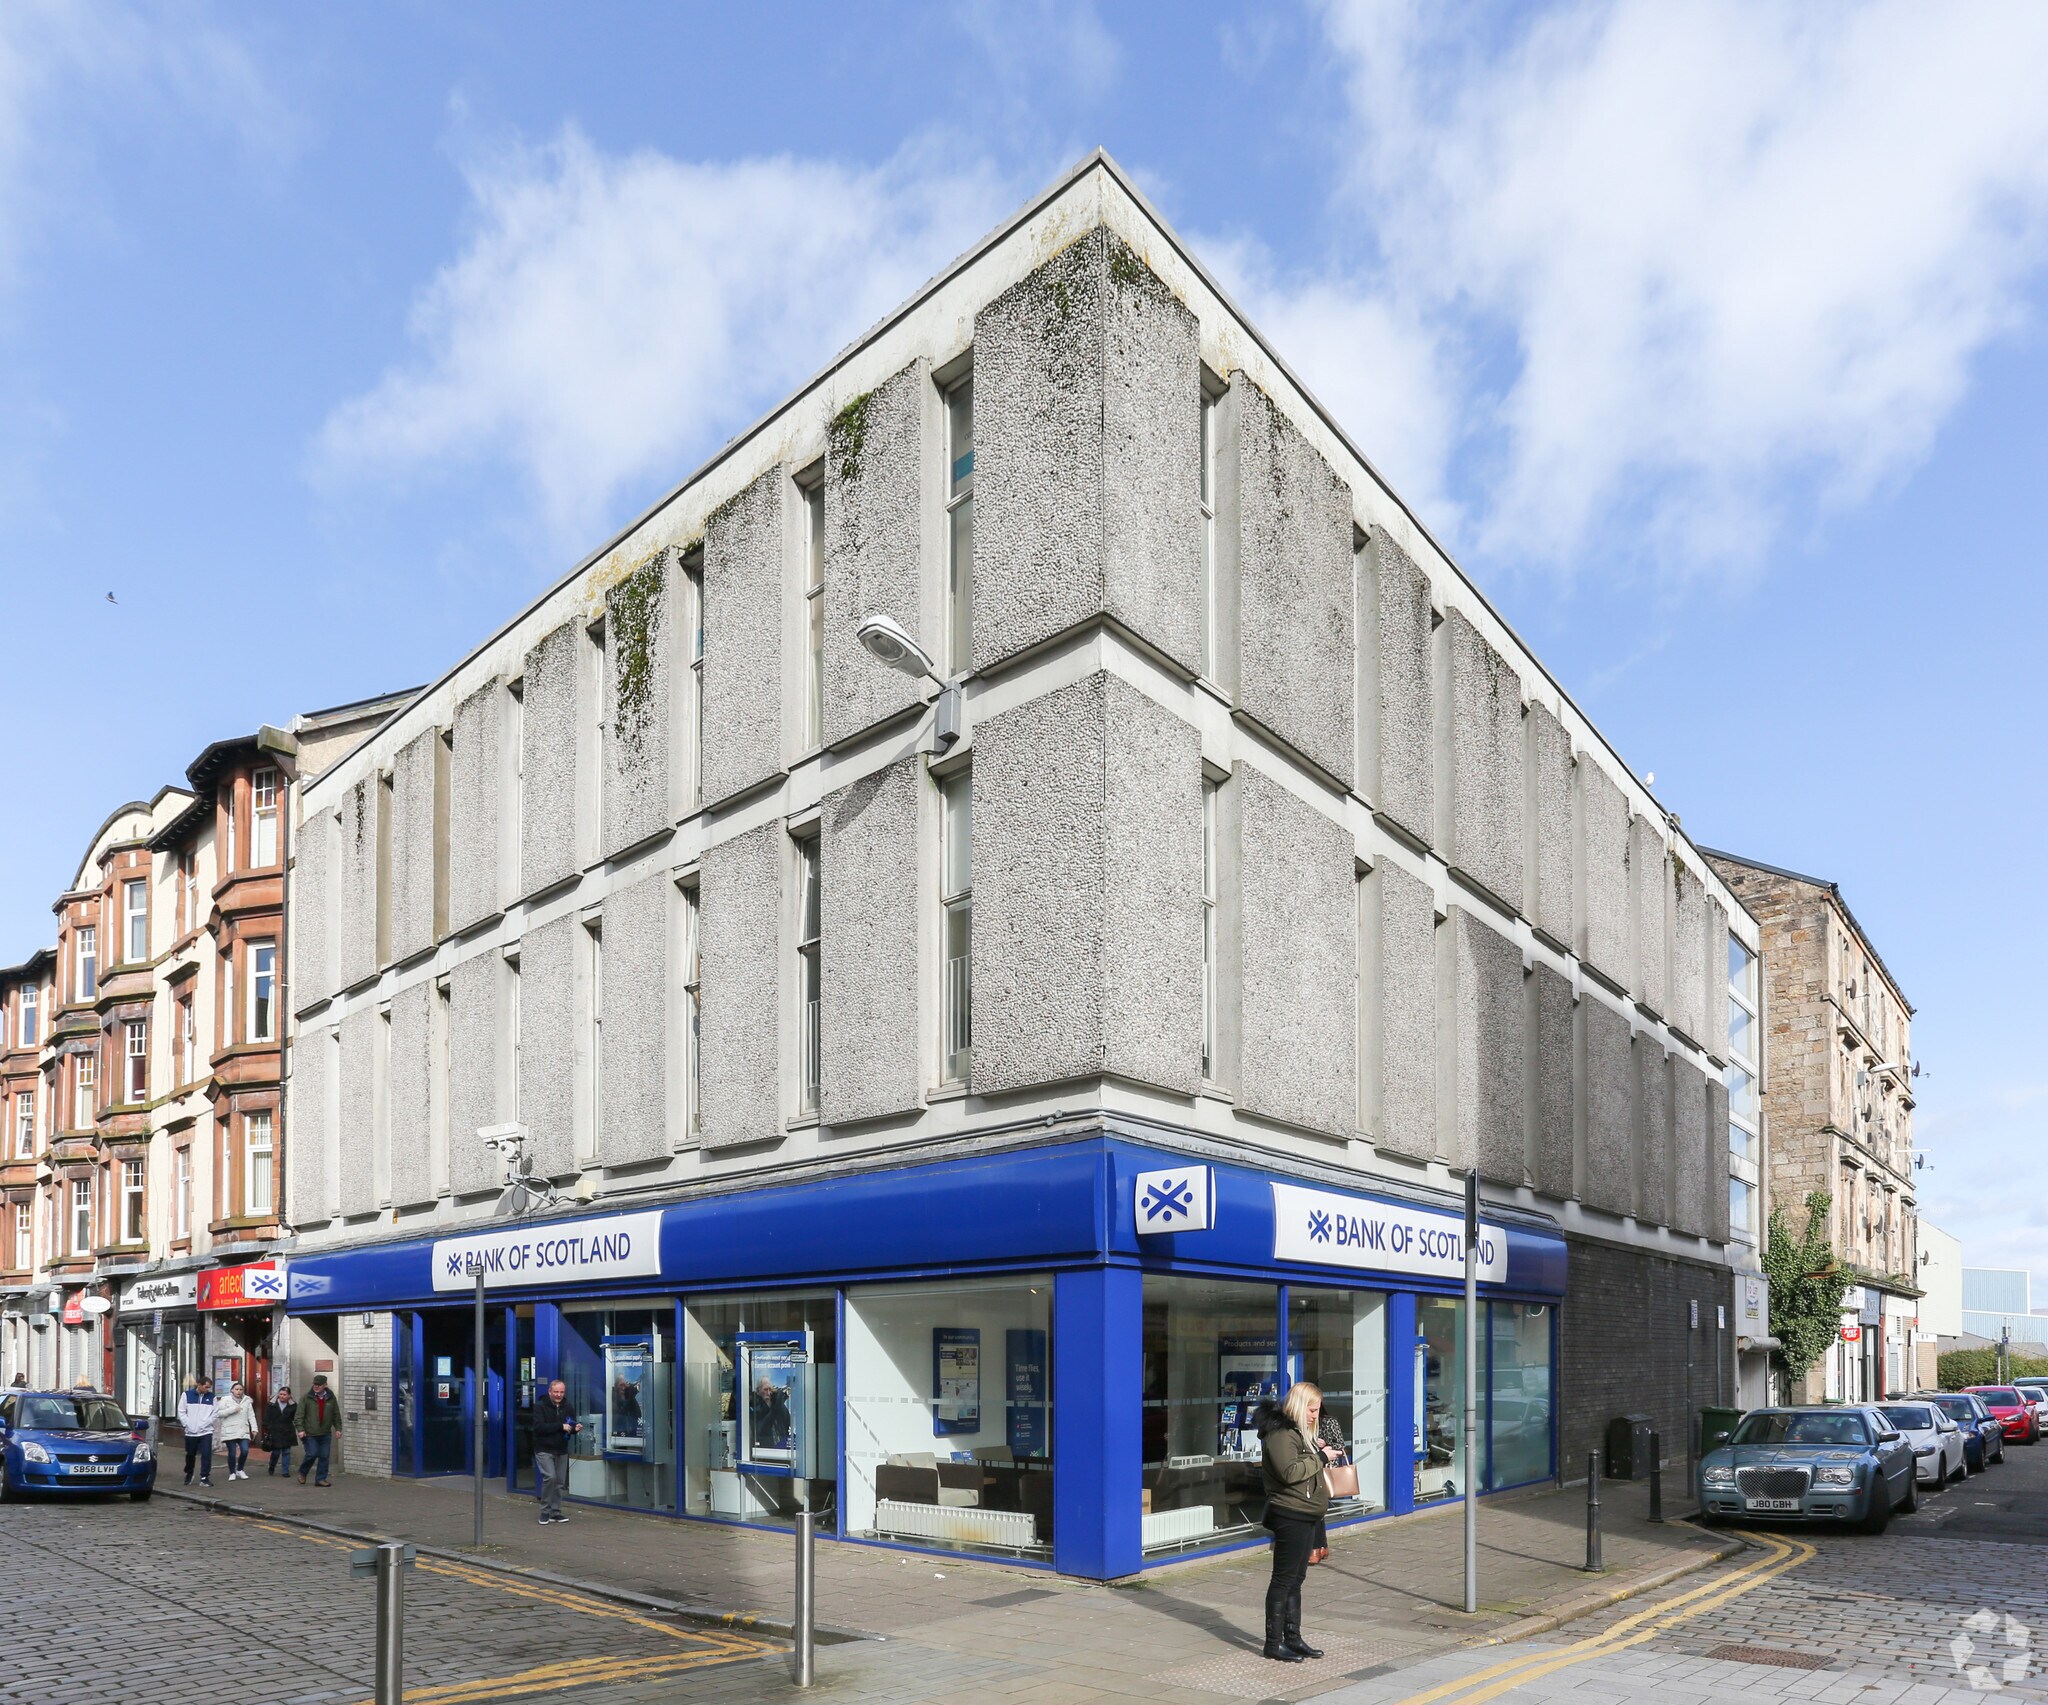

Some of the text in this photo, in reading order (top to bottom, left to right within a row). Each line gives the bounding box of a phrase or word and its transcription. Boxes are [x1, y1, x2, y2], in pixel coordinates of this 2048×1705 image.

[1336, 1214, 1495, 1266] BANK OF SCOTLND
[465, 1232, 631, 1275] BANK OF SCOTLAND
[1224, 1339, 1251, 1347] Products
[1253, 1339, 1265, 1347] and
[1015, 1363, 1028, 1373] Time
[1015, 1374, 1025, 1382] use
[73, 1465, 115, 1473] SB58 LVH
[1772, 1500, 1792, 1509] GBH
